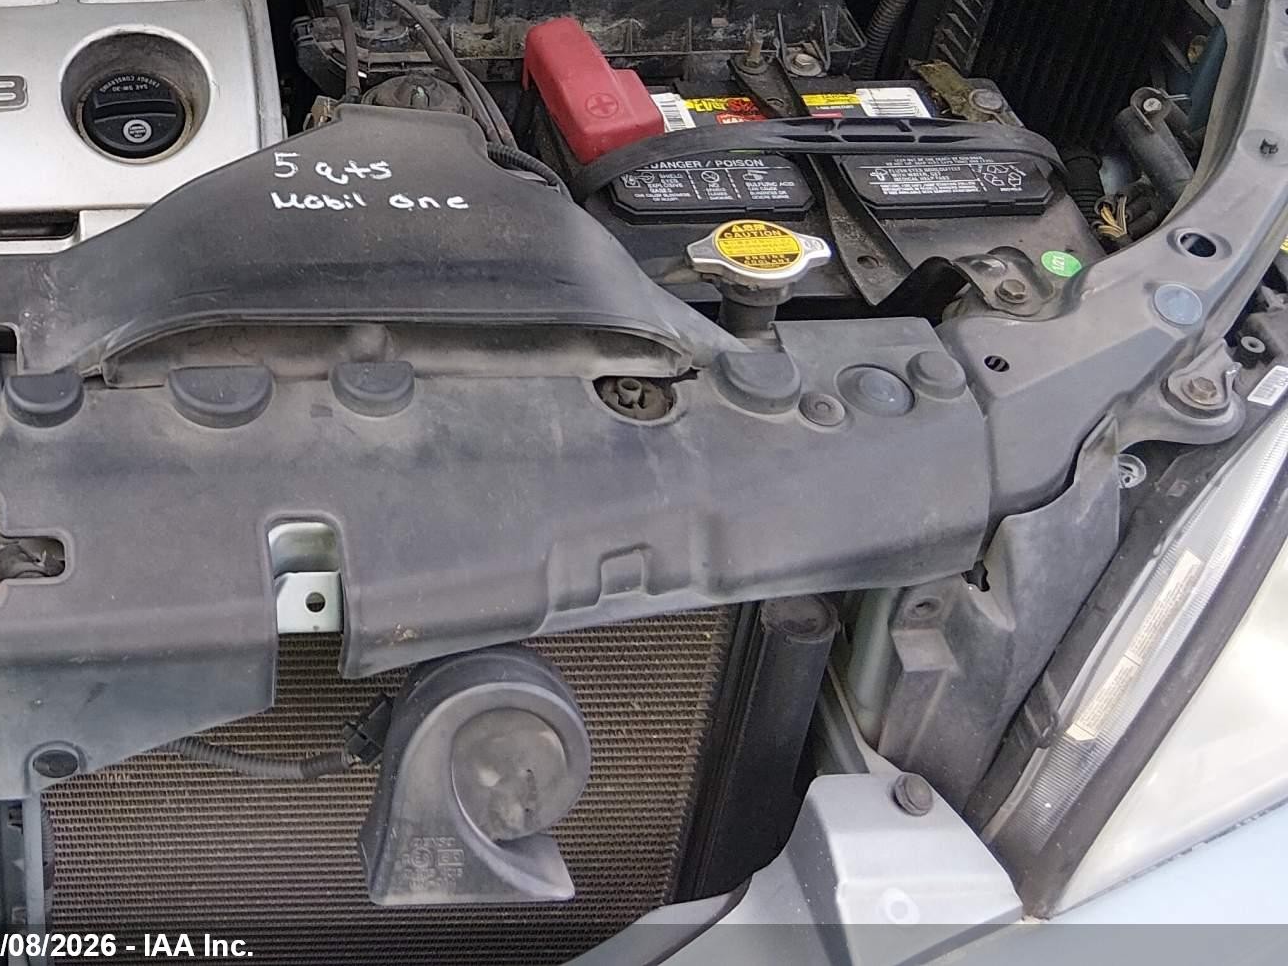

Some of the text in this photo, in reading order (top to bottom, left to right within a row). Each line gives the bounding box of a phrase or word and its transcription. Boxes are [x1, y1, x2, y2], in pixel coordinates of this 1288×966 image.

[274, 152, 300, 178] 5
[715, 159, 765, 167] POISON
[724, 230, 784, 239] CAUTION
